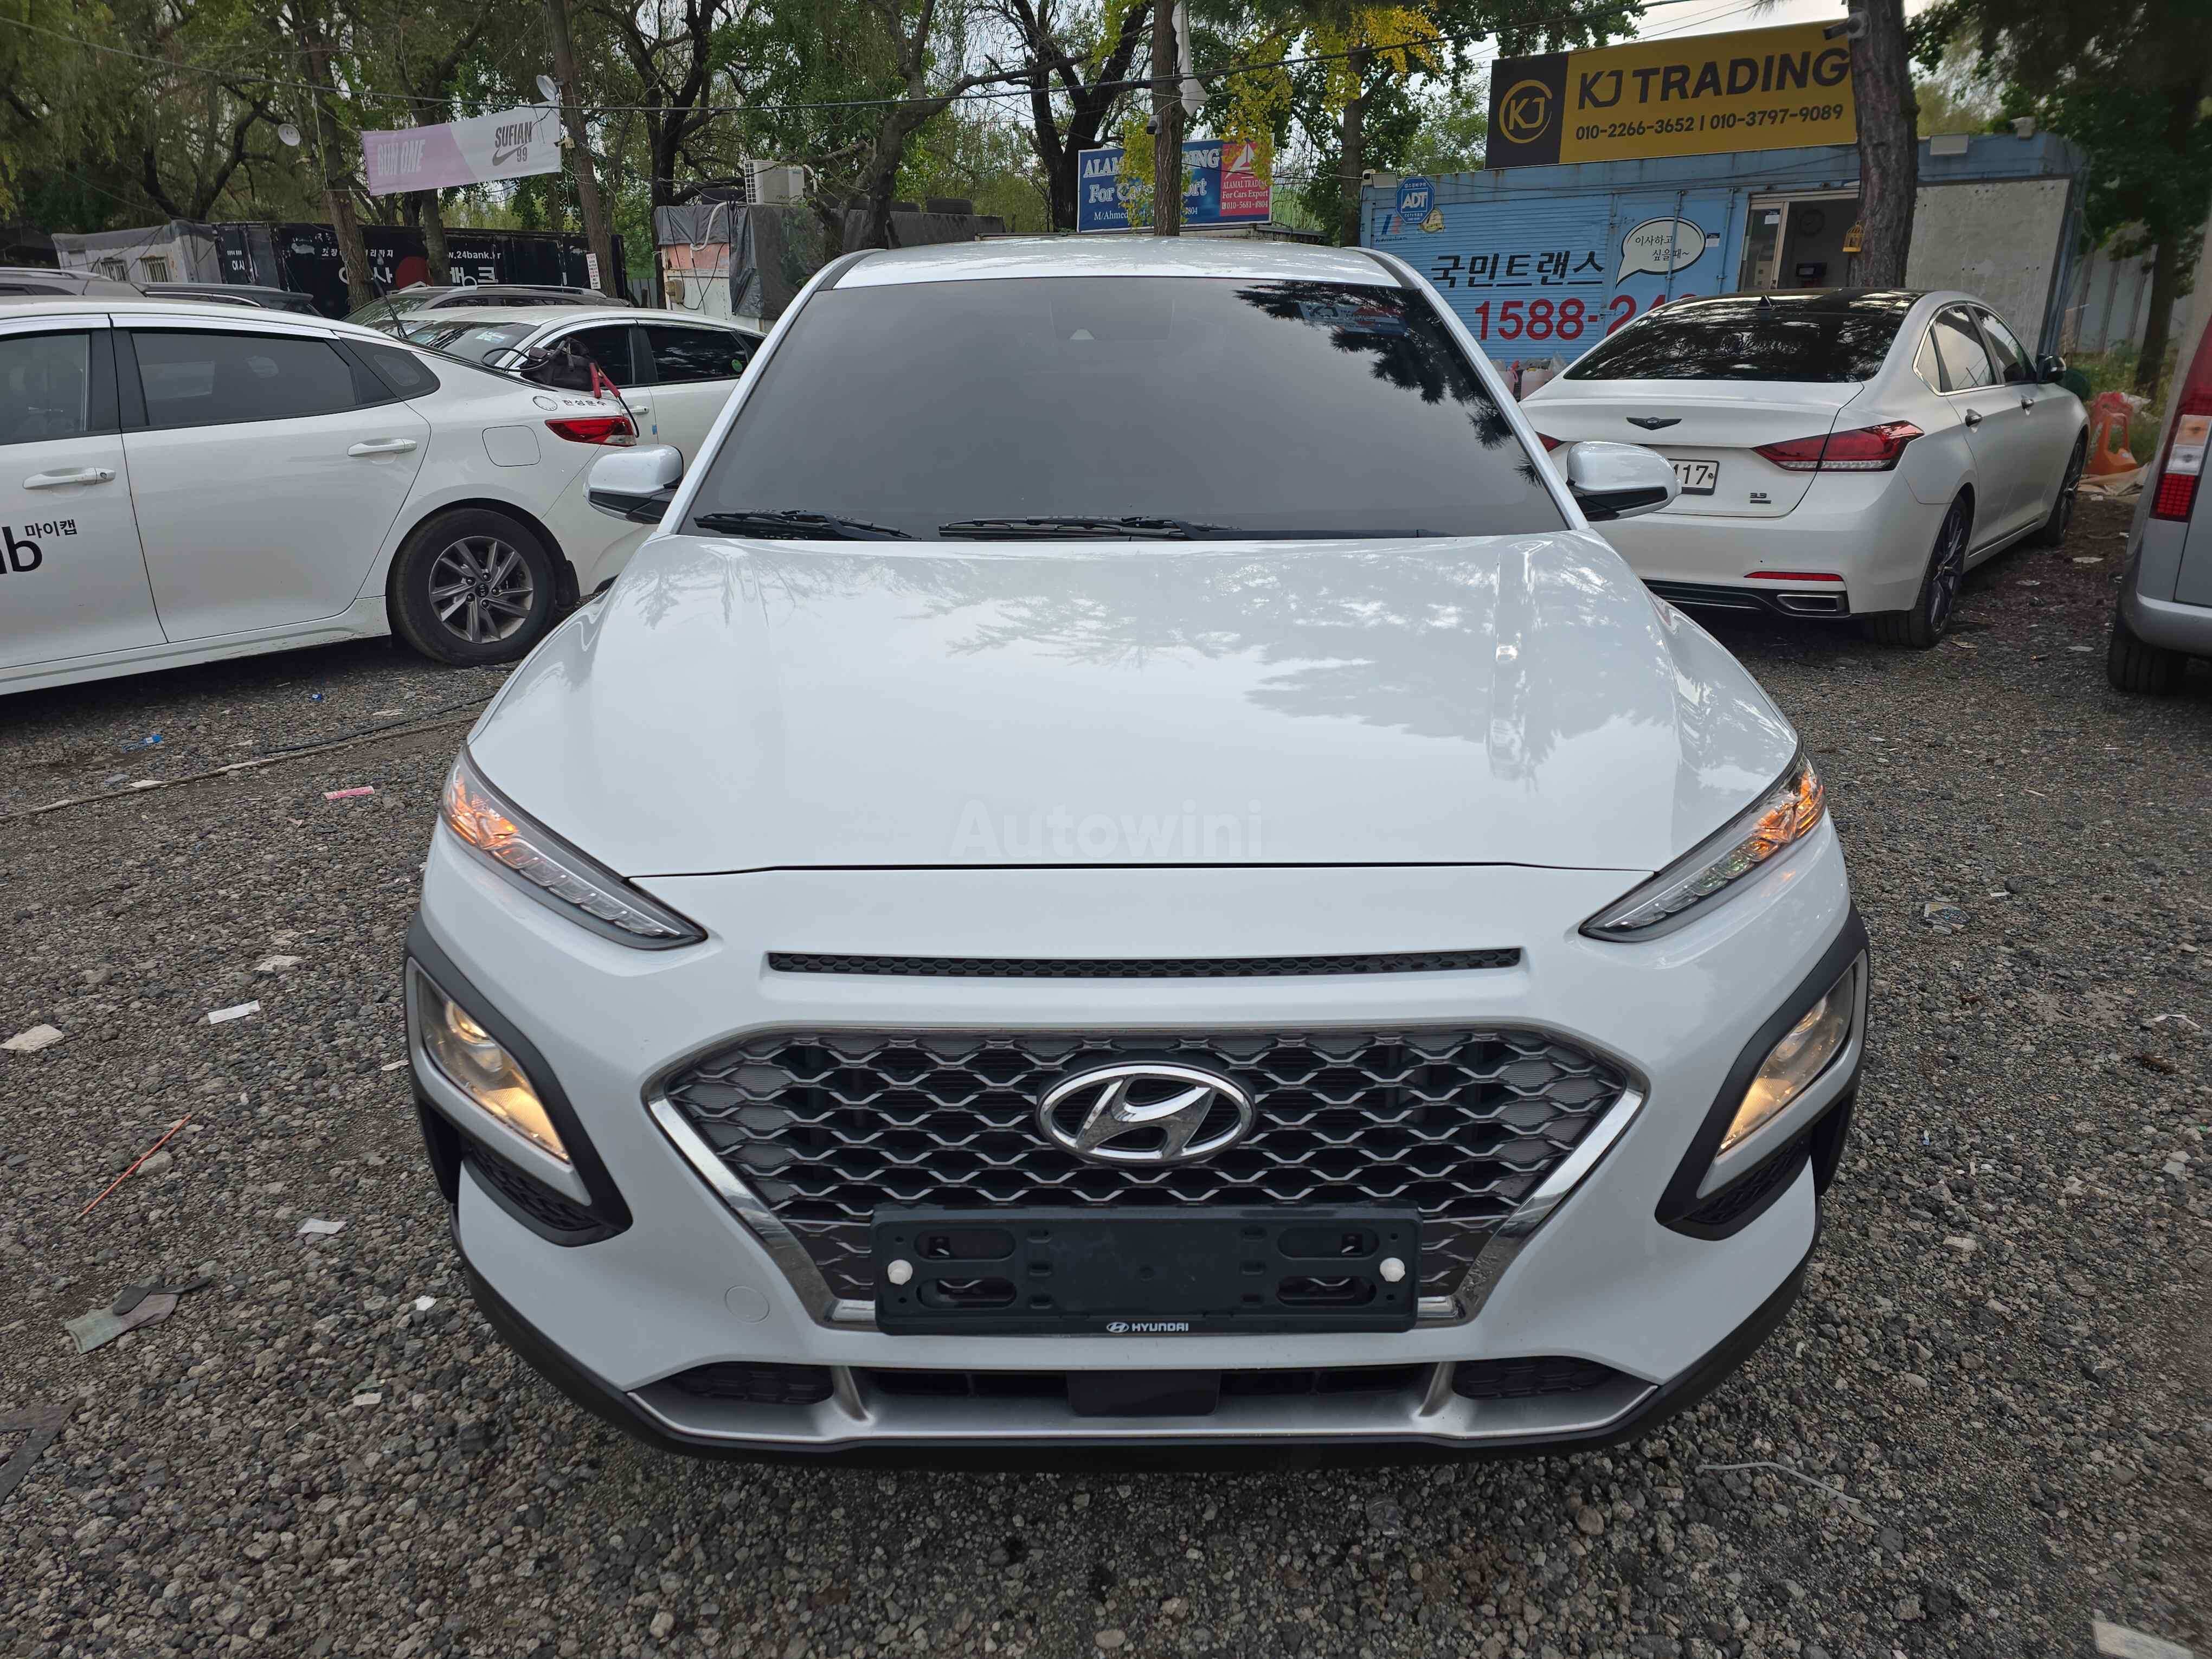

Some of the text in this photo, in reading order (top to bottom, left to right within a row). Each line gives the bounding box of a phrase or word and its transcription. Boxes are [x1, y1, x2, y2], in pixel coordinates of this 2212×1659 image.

[1578, 48, 1850, 110] KJ TRADING
[1576, 115, 1694, 140] 010-2266-3652
[1710, 104, 1843, 130] 010-3797-9089
[494, 121, 532, 148] SUFIAN
[517, 146, 528, 162] 99
[1089, 184, 1115, 203] For
[1223, 180, 1243, 189] ALAMAL
[1223, 191, 1233, 199] For
[1249, 190, 1268, 199] Export
[1401, 191, 1429, 209] ADT
[1635, 235, 1674, 247] 이사하고
[1431, 250, 1605, 288] 국민트랜스
[24, 519, 78, 539] 마이캡
[1131, 1322, 1189, 1332] HYUNDAI
